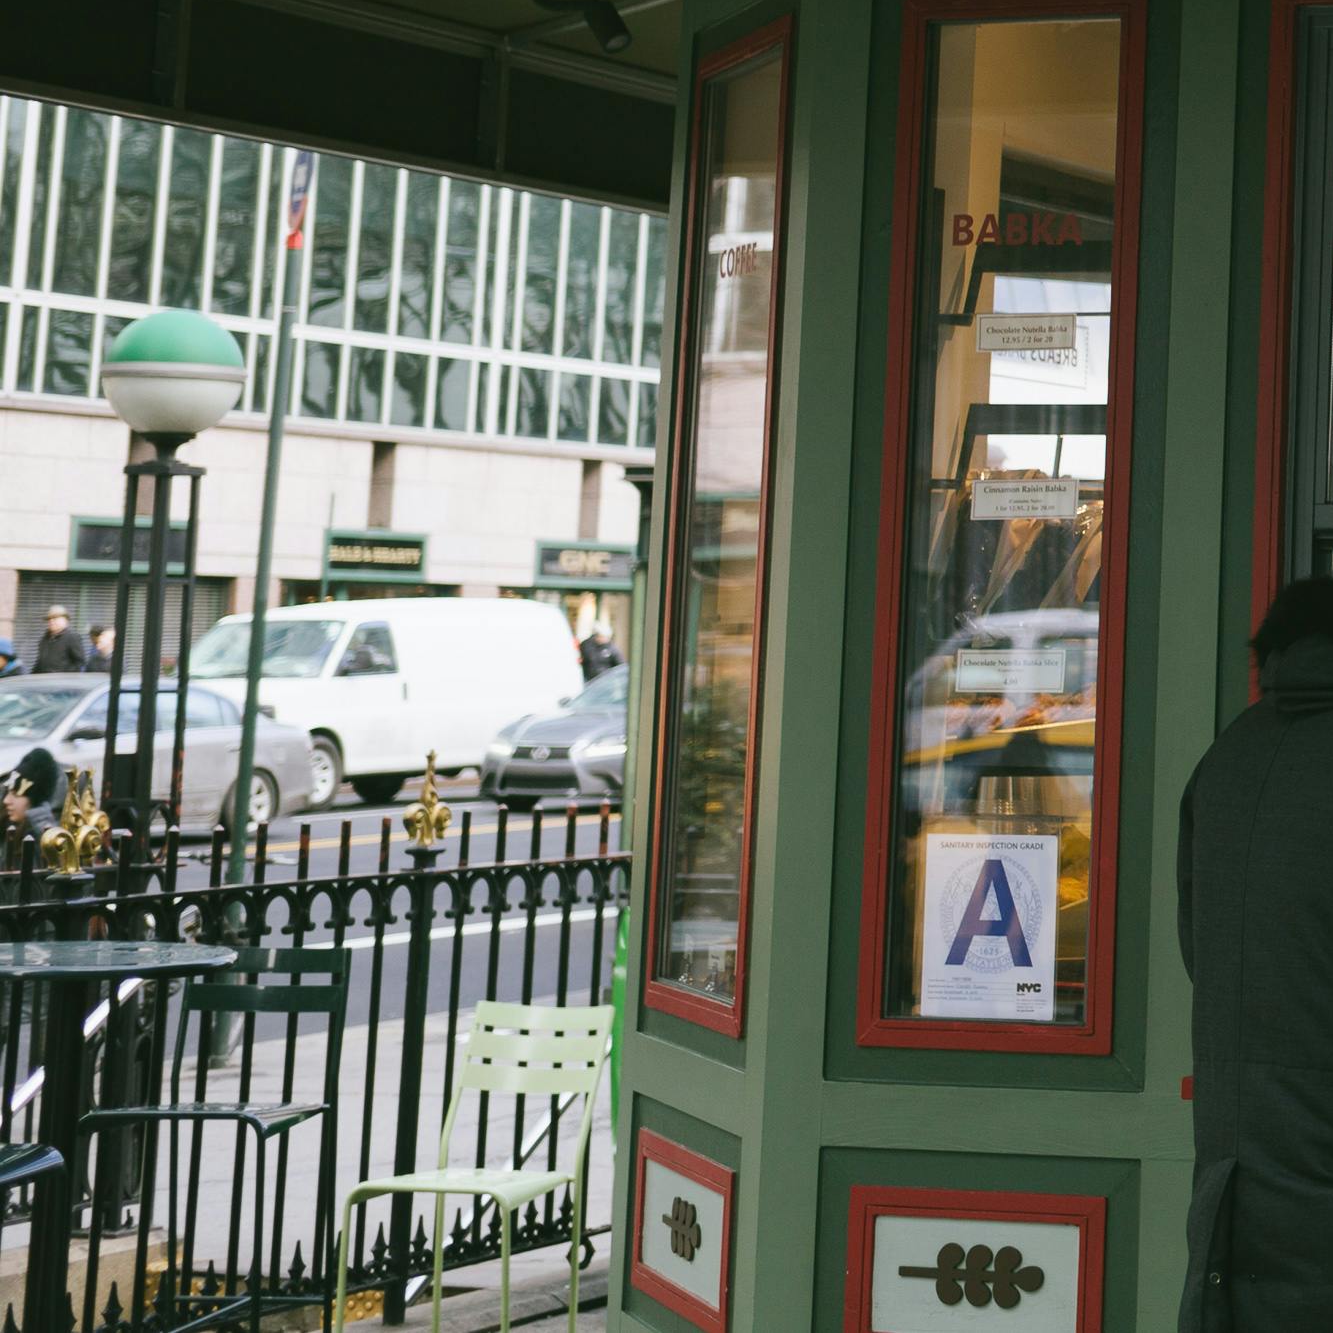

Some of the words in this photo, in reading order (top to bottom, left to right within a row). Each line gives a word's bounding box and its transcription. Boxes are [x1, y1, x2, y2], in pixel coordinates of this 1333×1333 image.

[952, 213, 1083, 247] BABKA
[719, 242, 758, 279] COFFEE
[941, 841, 974, 849] SANITARY
[976, 841, 1018, 850] INSPECTION
[1020, 842, 1044, 851] GRADE
[945, 859, 1033, 967] A
[1016, 982, 1042, 993] NYC
